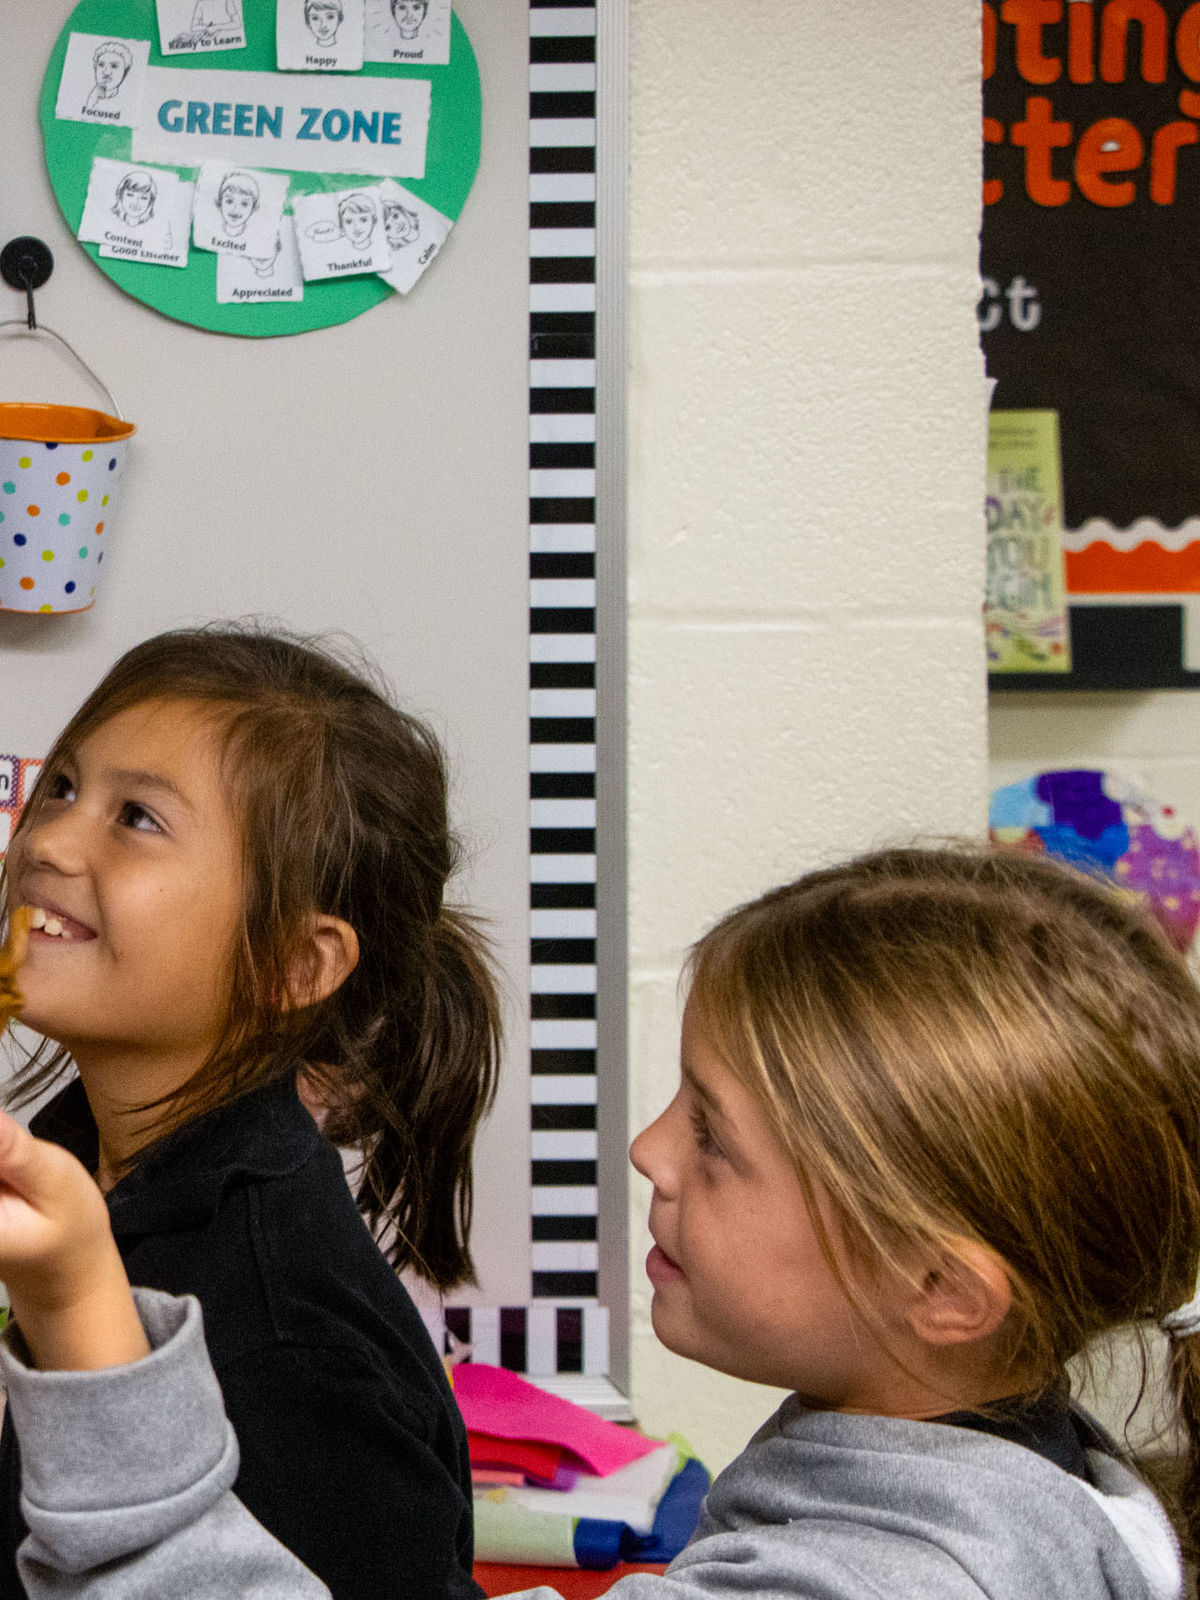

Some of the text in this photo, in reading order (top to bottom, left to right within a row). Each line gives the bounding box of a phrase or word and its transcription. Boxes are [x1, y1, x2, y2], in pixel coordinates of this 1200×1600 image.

[201, 39, 212, 48] to
[214, 36, 242, 46] Learn
[393, 49, 424, 59] Proud
[305, 55, 338, 68] Happy
[81, 105, 121, 120] Focused
[157, 99, 402, 145] GREEN ZONE
[104, 230, 144, 248] Content
[211, 237, 247, 251] Excited
[418, 242, 438, 266] Calm
[327, 258, 373, 272] Thankful
[232, 287, 293, 300] Appreciated
